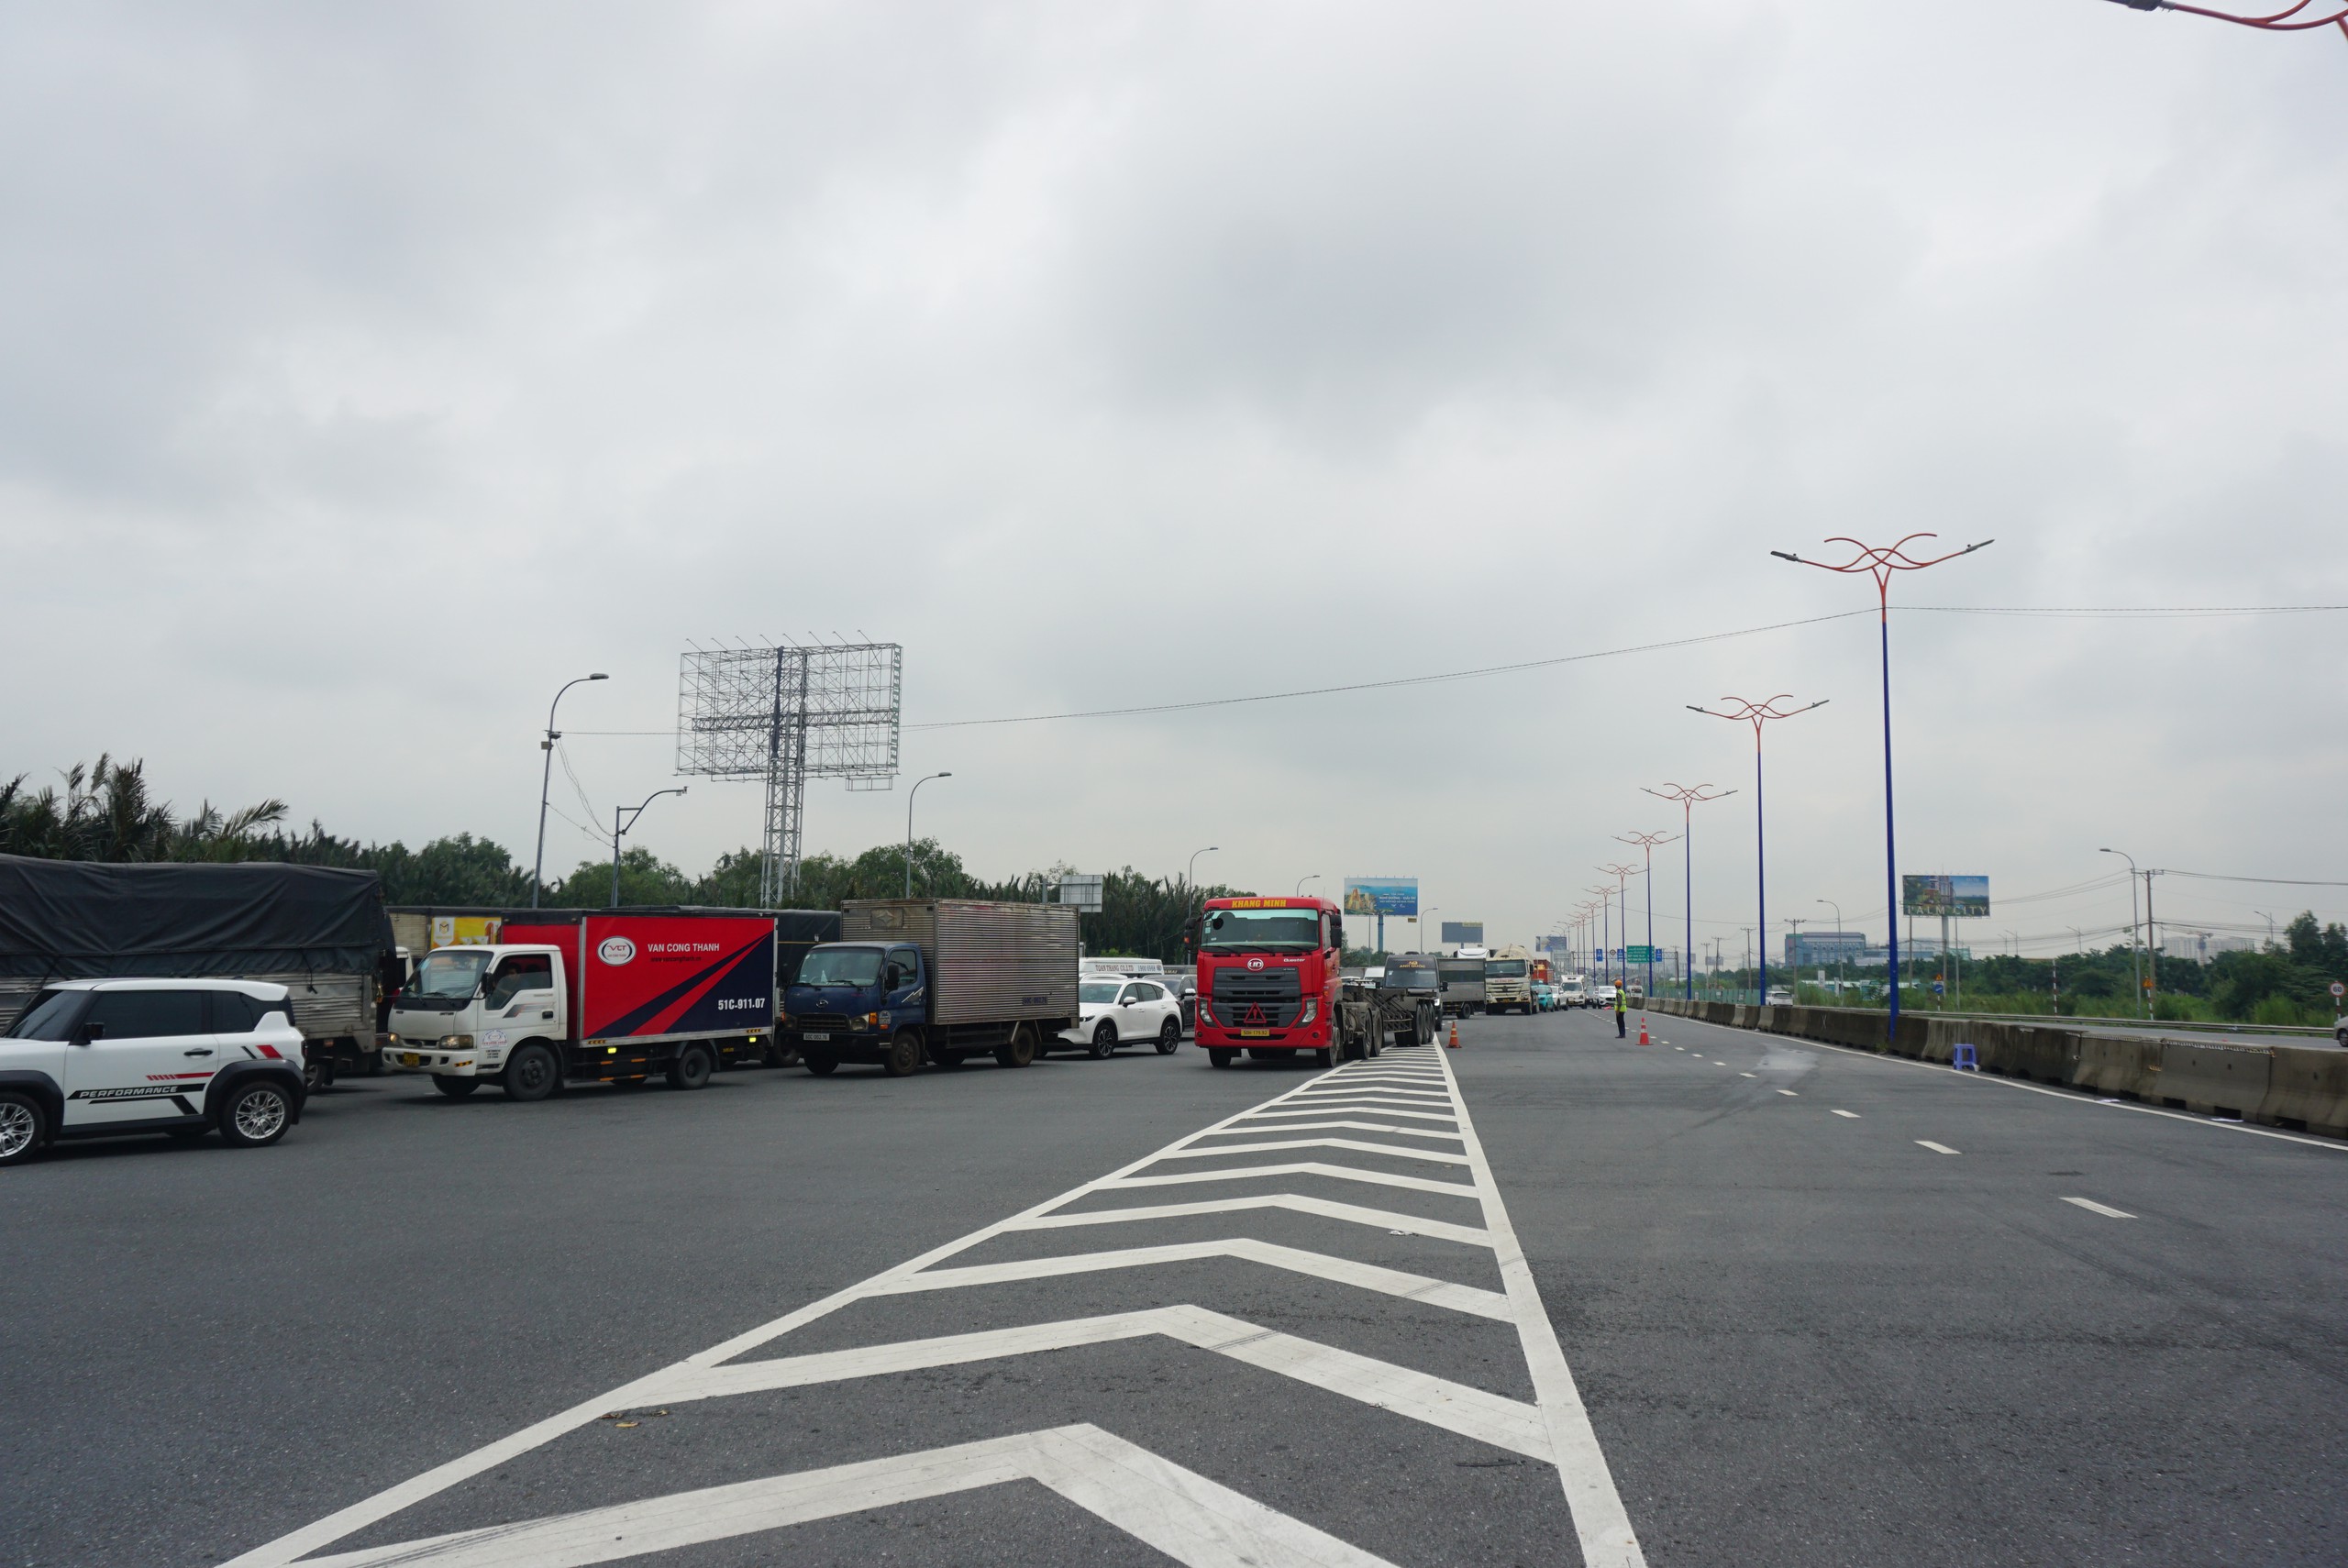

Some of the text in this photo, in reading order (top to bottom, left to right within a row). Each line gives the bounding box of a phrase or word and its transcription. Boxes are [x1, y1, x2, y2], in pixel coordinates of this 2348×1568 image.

[1231, 900, 1287, 909] KHANG MINH
[1908, 905, 1988, 915] PALM CITY
[648, 943, 720, 953] VAN CONG THANH
[718, 998, 765, 1010] 51C-911.07
[79, 1086, 178, 1099] PERFORMANCE
